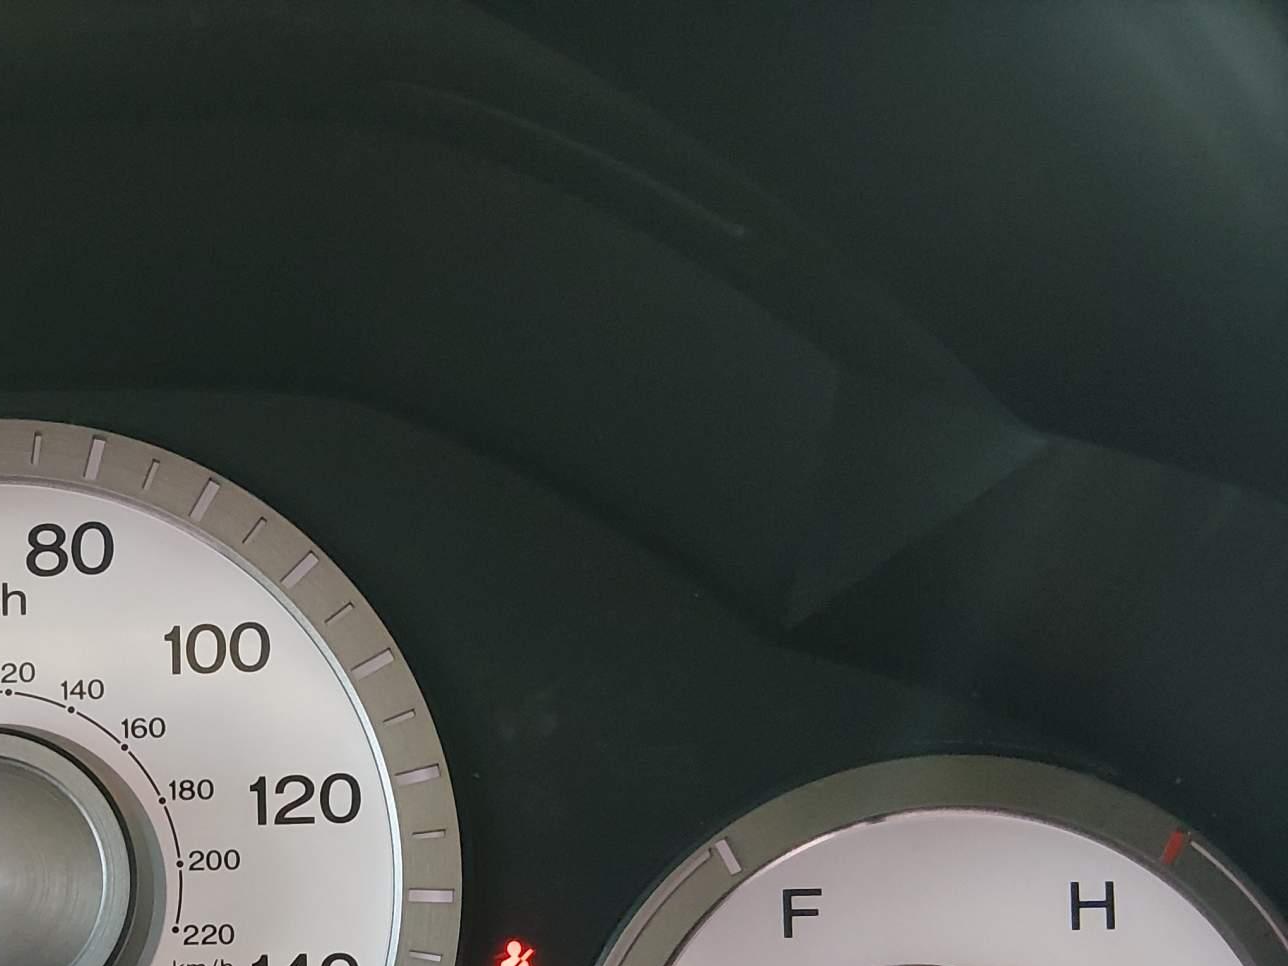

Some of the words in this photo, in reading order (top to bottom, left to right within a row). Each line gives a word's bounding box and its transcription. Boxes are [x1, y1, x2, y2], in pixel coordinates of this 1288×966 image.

[26, 521, 115, 577] 80
[164, 621, 271, 674] 100
[60, 678, 105, 701] 140
[121, 716, 166, 740] 160
[169, 779, 214, 802] 180
[249, 773, 361, 826] 120
[188, 849, 241, 872] 200
[783, 888, 822, 938] F
[1070, 881, 1116, 930] H
[183, 923, 235, 946] 220
